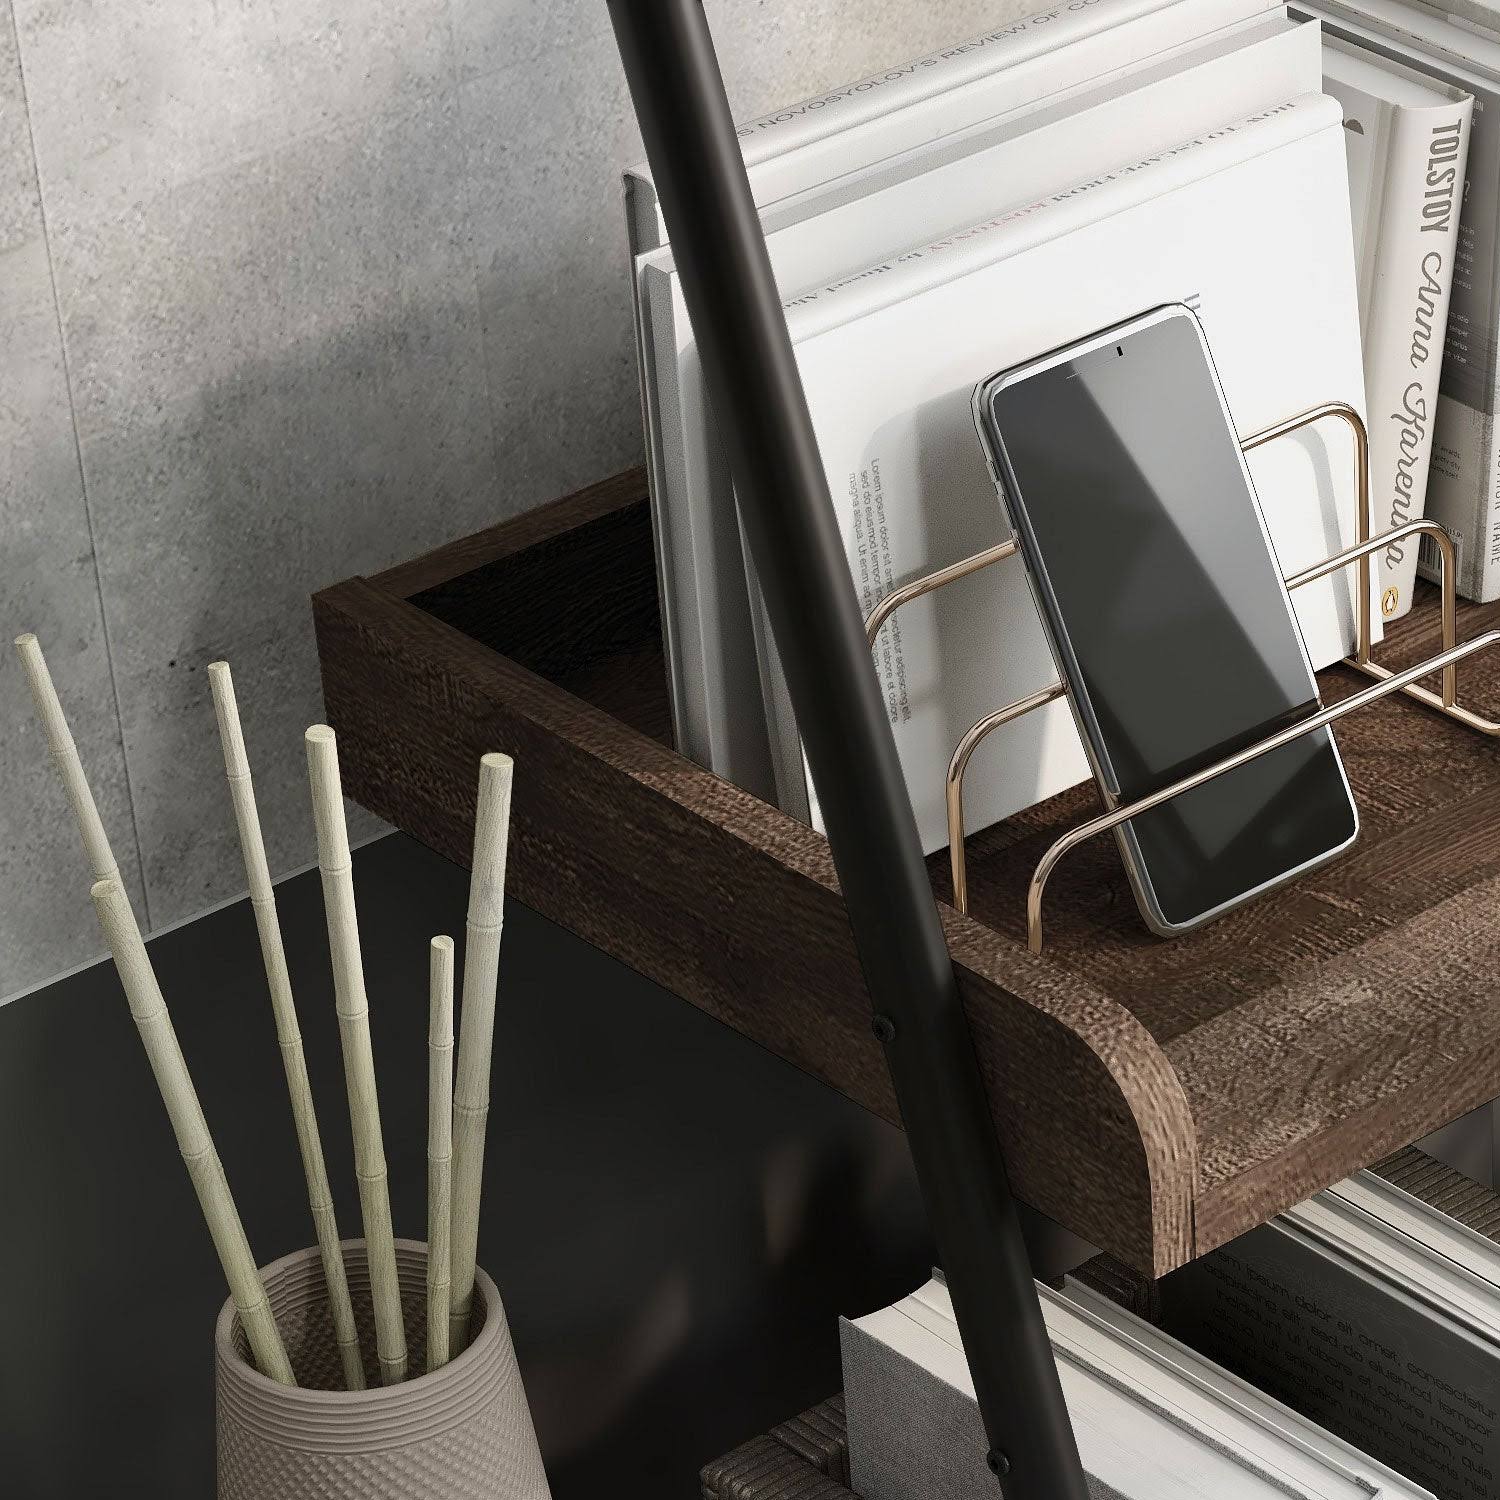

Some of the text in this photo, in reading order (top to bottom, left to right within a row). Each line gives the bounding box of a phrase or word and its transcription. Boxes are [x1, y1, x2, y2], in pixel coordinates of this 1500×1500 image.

[1032, 10, 1059, 27] OF
[1420, 118, 1462, 232] TOLSTOY
[1410, 251, 1442, 369] Anna
